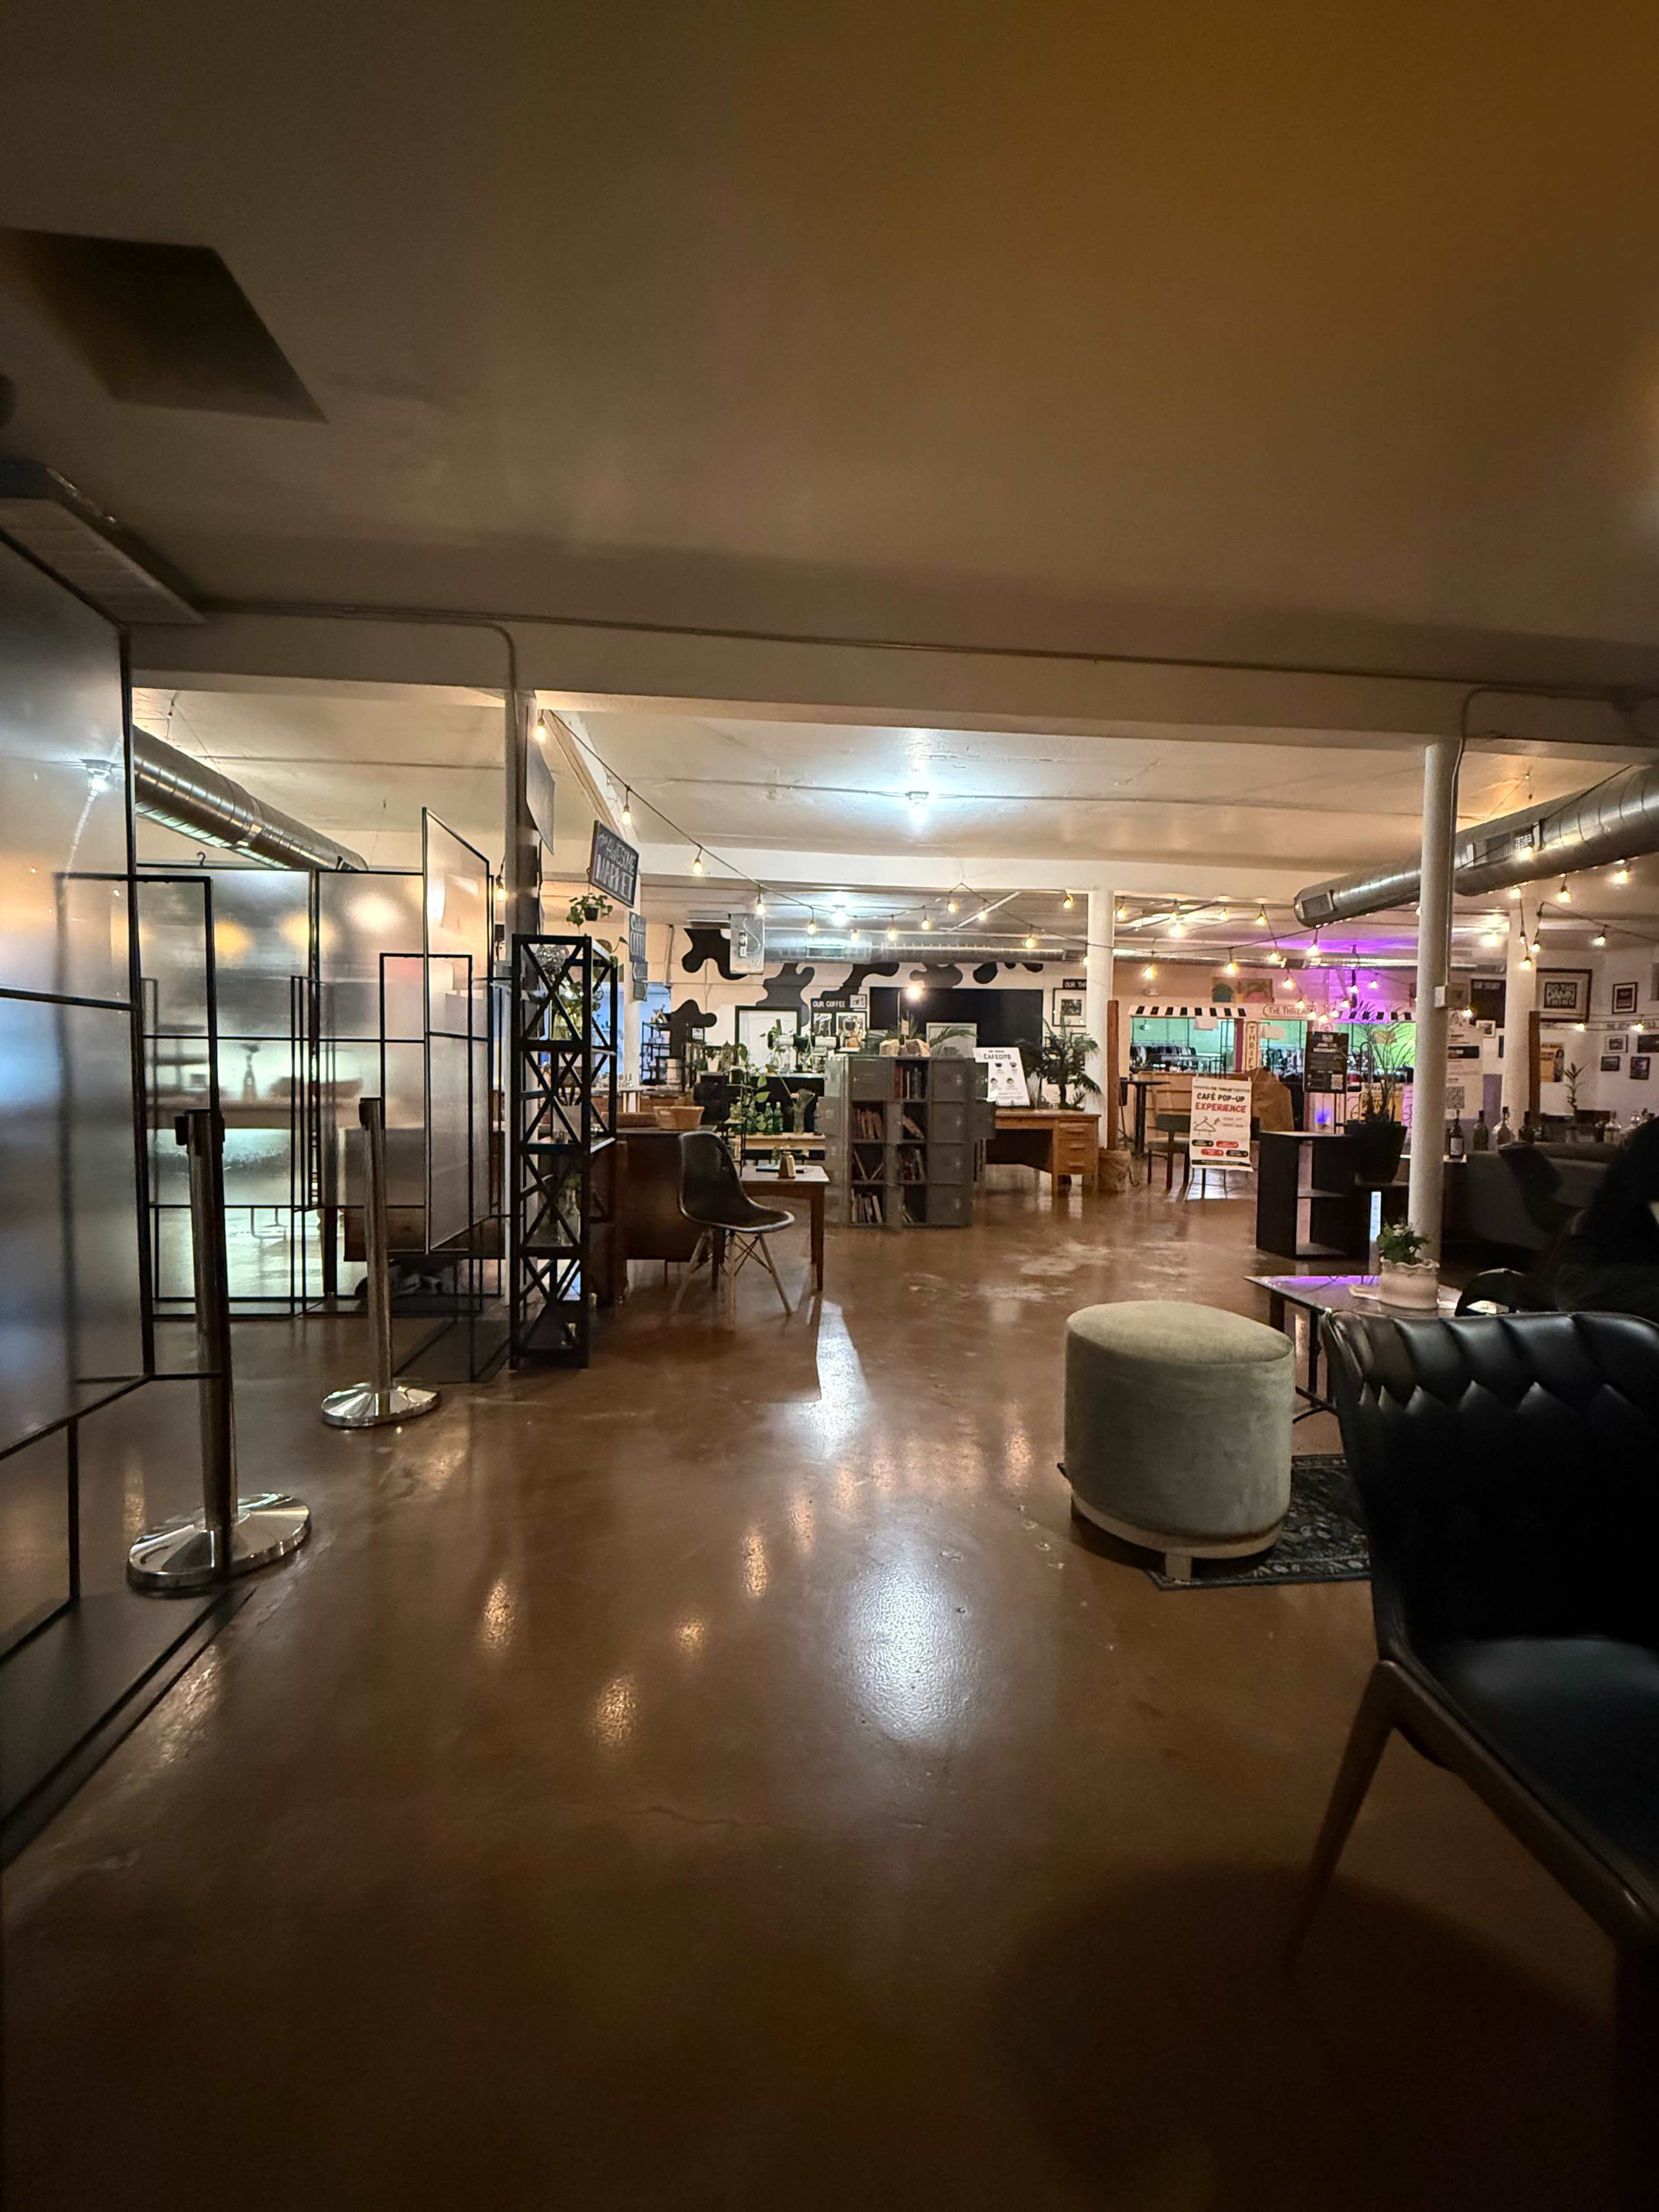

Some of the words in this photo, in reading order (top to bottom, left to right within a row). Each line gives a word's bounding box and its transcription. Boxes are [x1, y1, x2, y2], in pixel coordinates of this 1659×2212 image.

[595, 854, 634, 900] MARKET
[1546, 991, 1575, 999] DAMN
[1197, 1092, 1215, 1101] CAFÉ
[1218, 1094, 1245, 1103] POP-UP
[1195, 1102, 1246, 1113] EXPERIENCE
